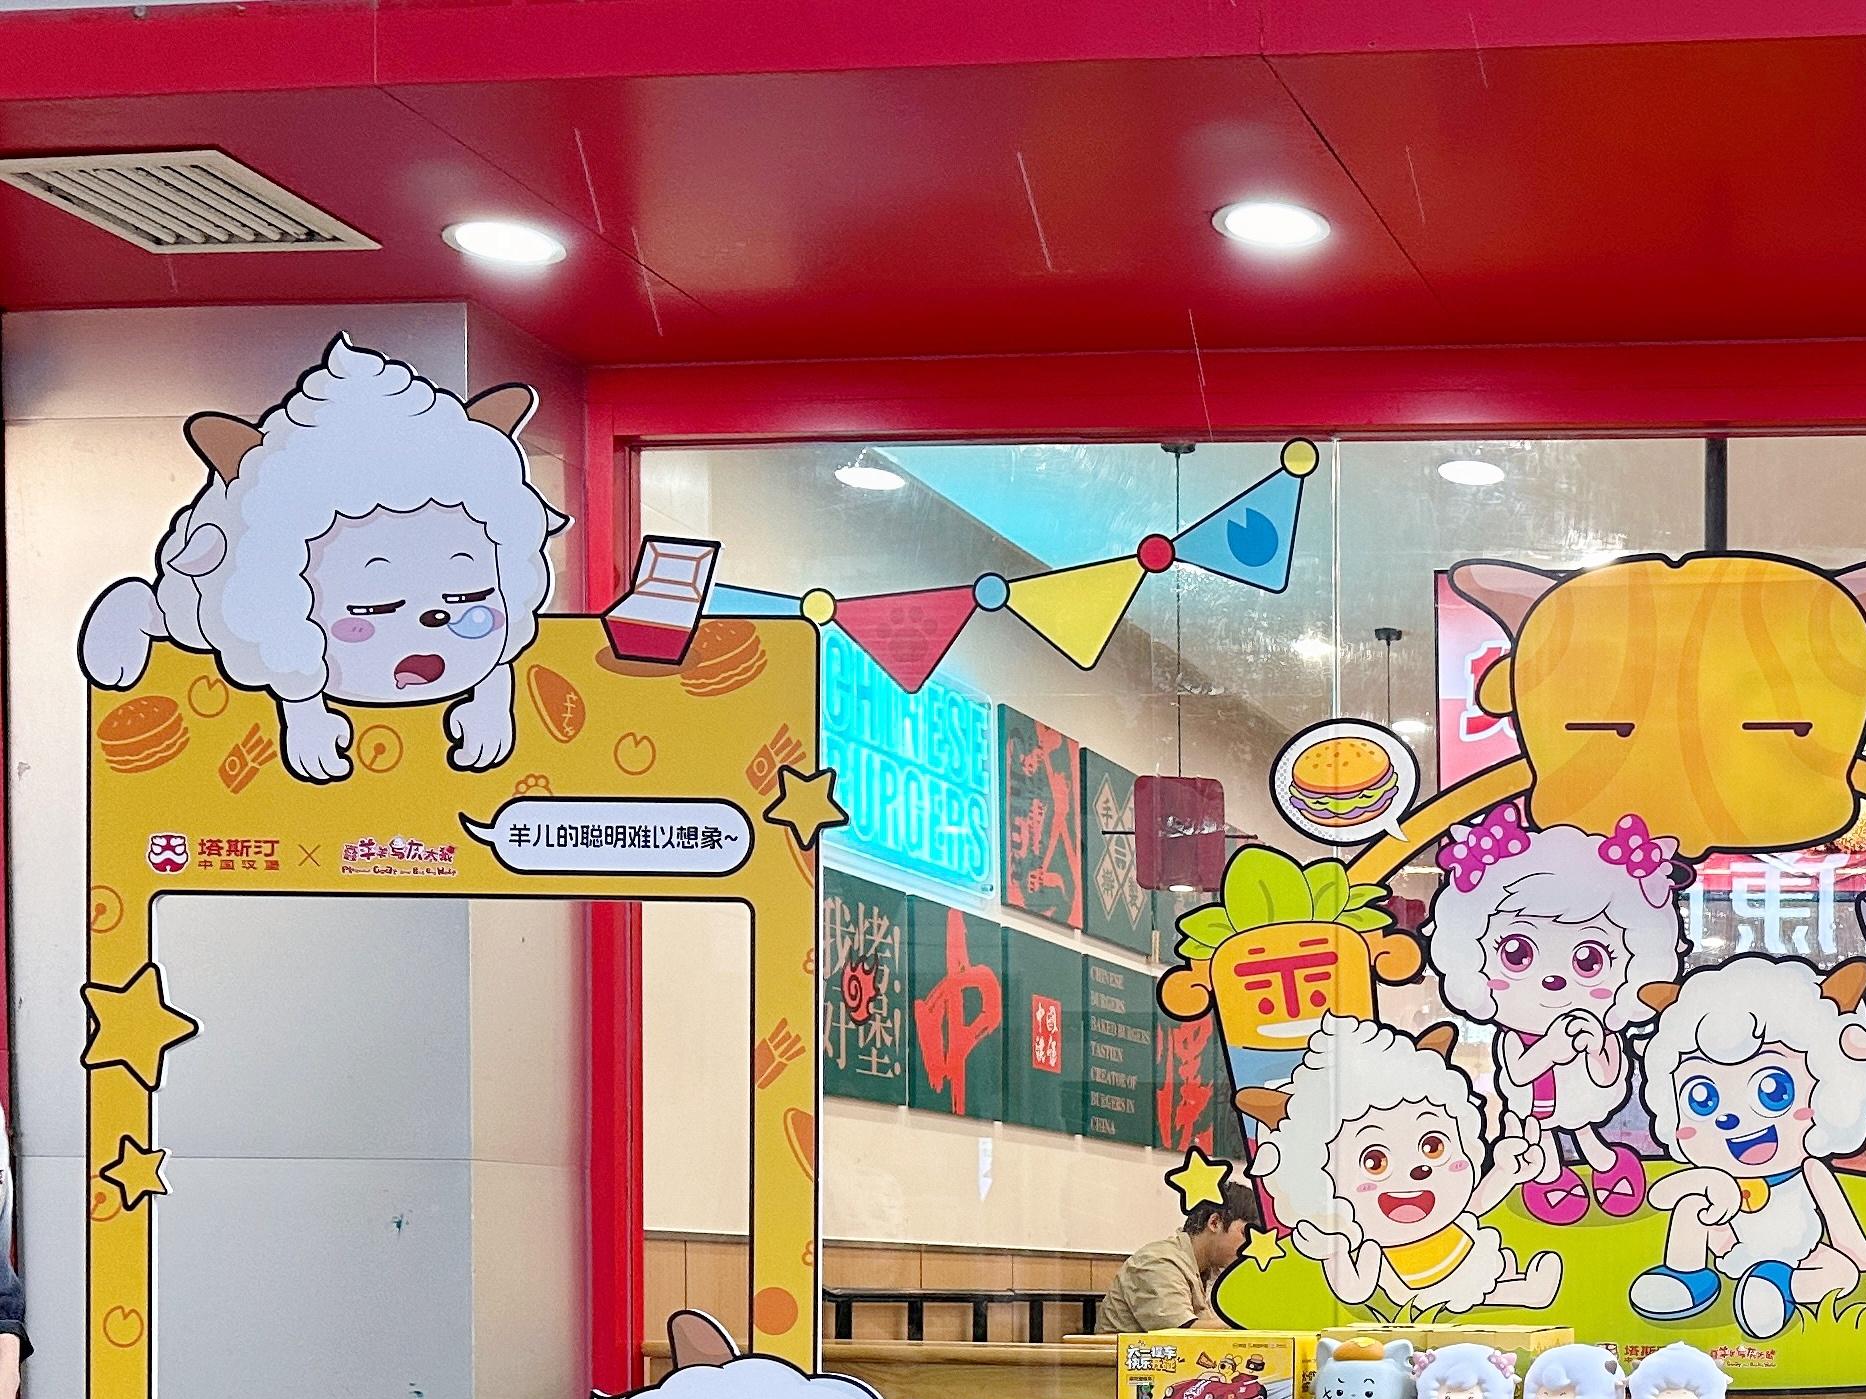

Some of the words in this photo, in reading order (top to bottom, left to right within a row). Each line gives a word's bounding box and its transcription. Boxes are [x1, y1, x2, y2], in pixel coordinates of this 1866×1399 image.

[198, 838, 280, 858] 塔斯汀
[508, 823, 738, 850] 羊儿的聪明难以想象~
